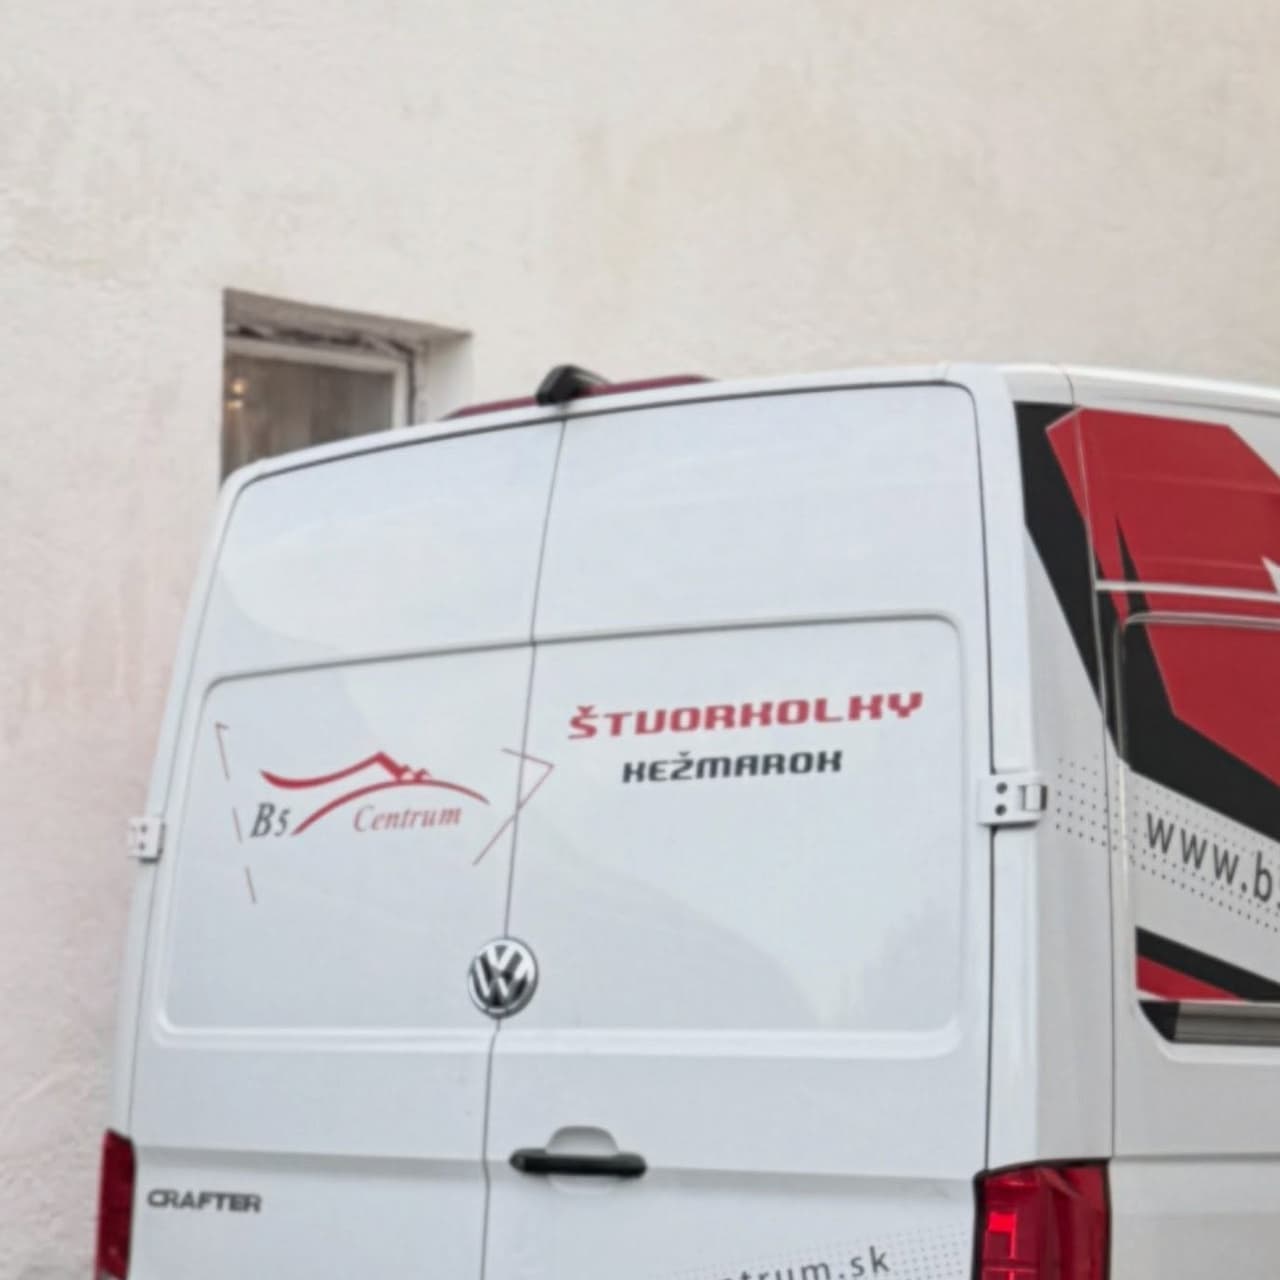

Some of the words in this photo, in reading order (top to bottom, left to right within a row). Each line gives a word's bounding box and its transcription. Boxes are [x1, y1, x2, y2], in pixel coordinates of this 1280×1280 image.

[621, 750, 843, 784] KEŽMAROK
[352, 802, 463, 834] Centrum
[1146, 811, 1280, 911] www.b
[145, 1188, 263, 1214] CRAFTER
